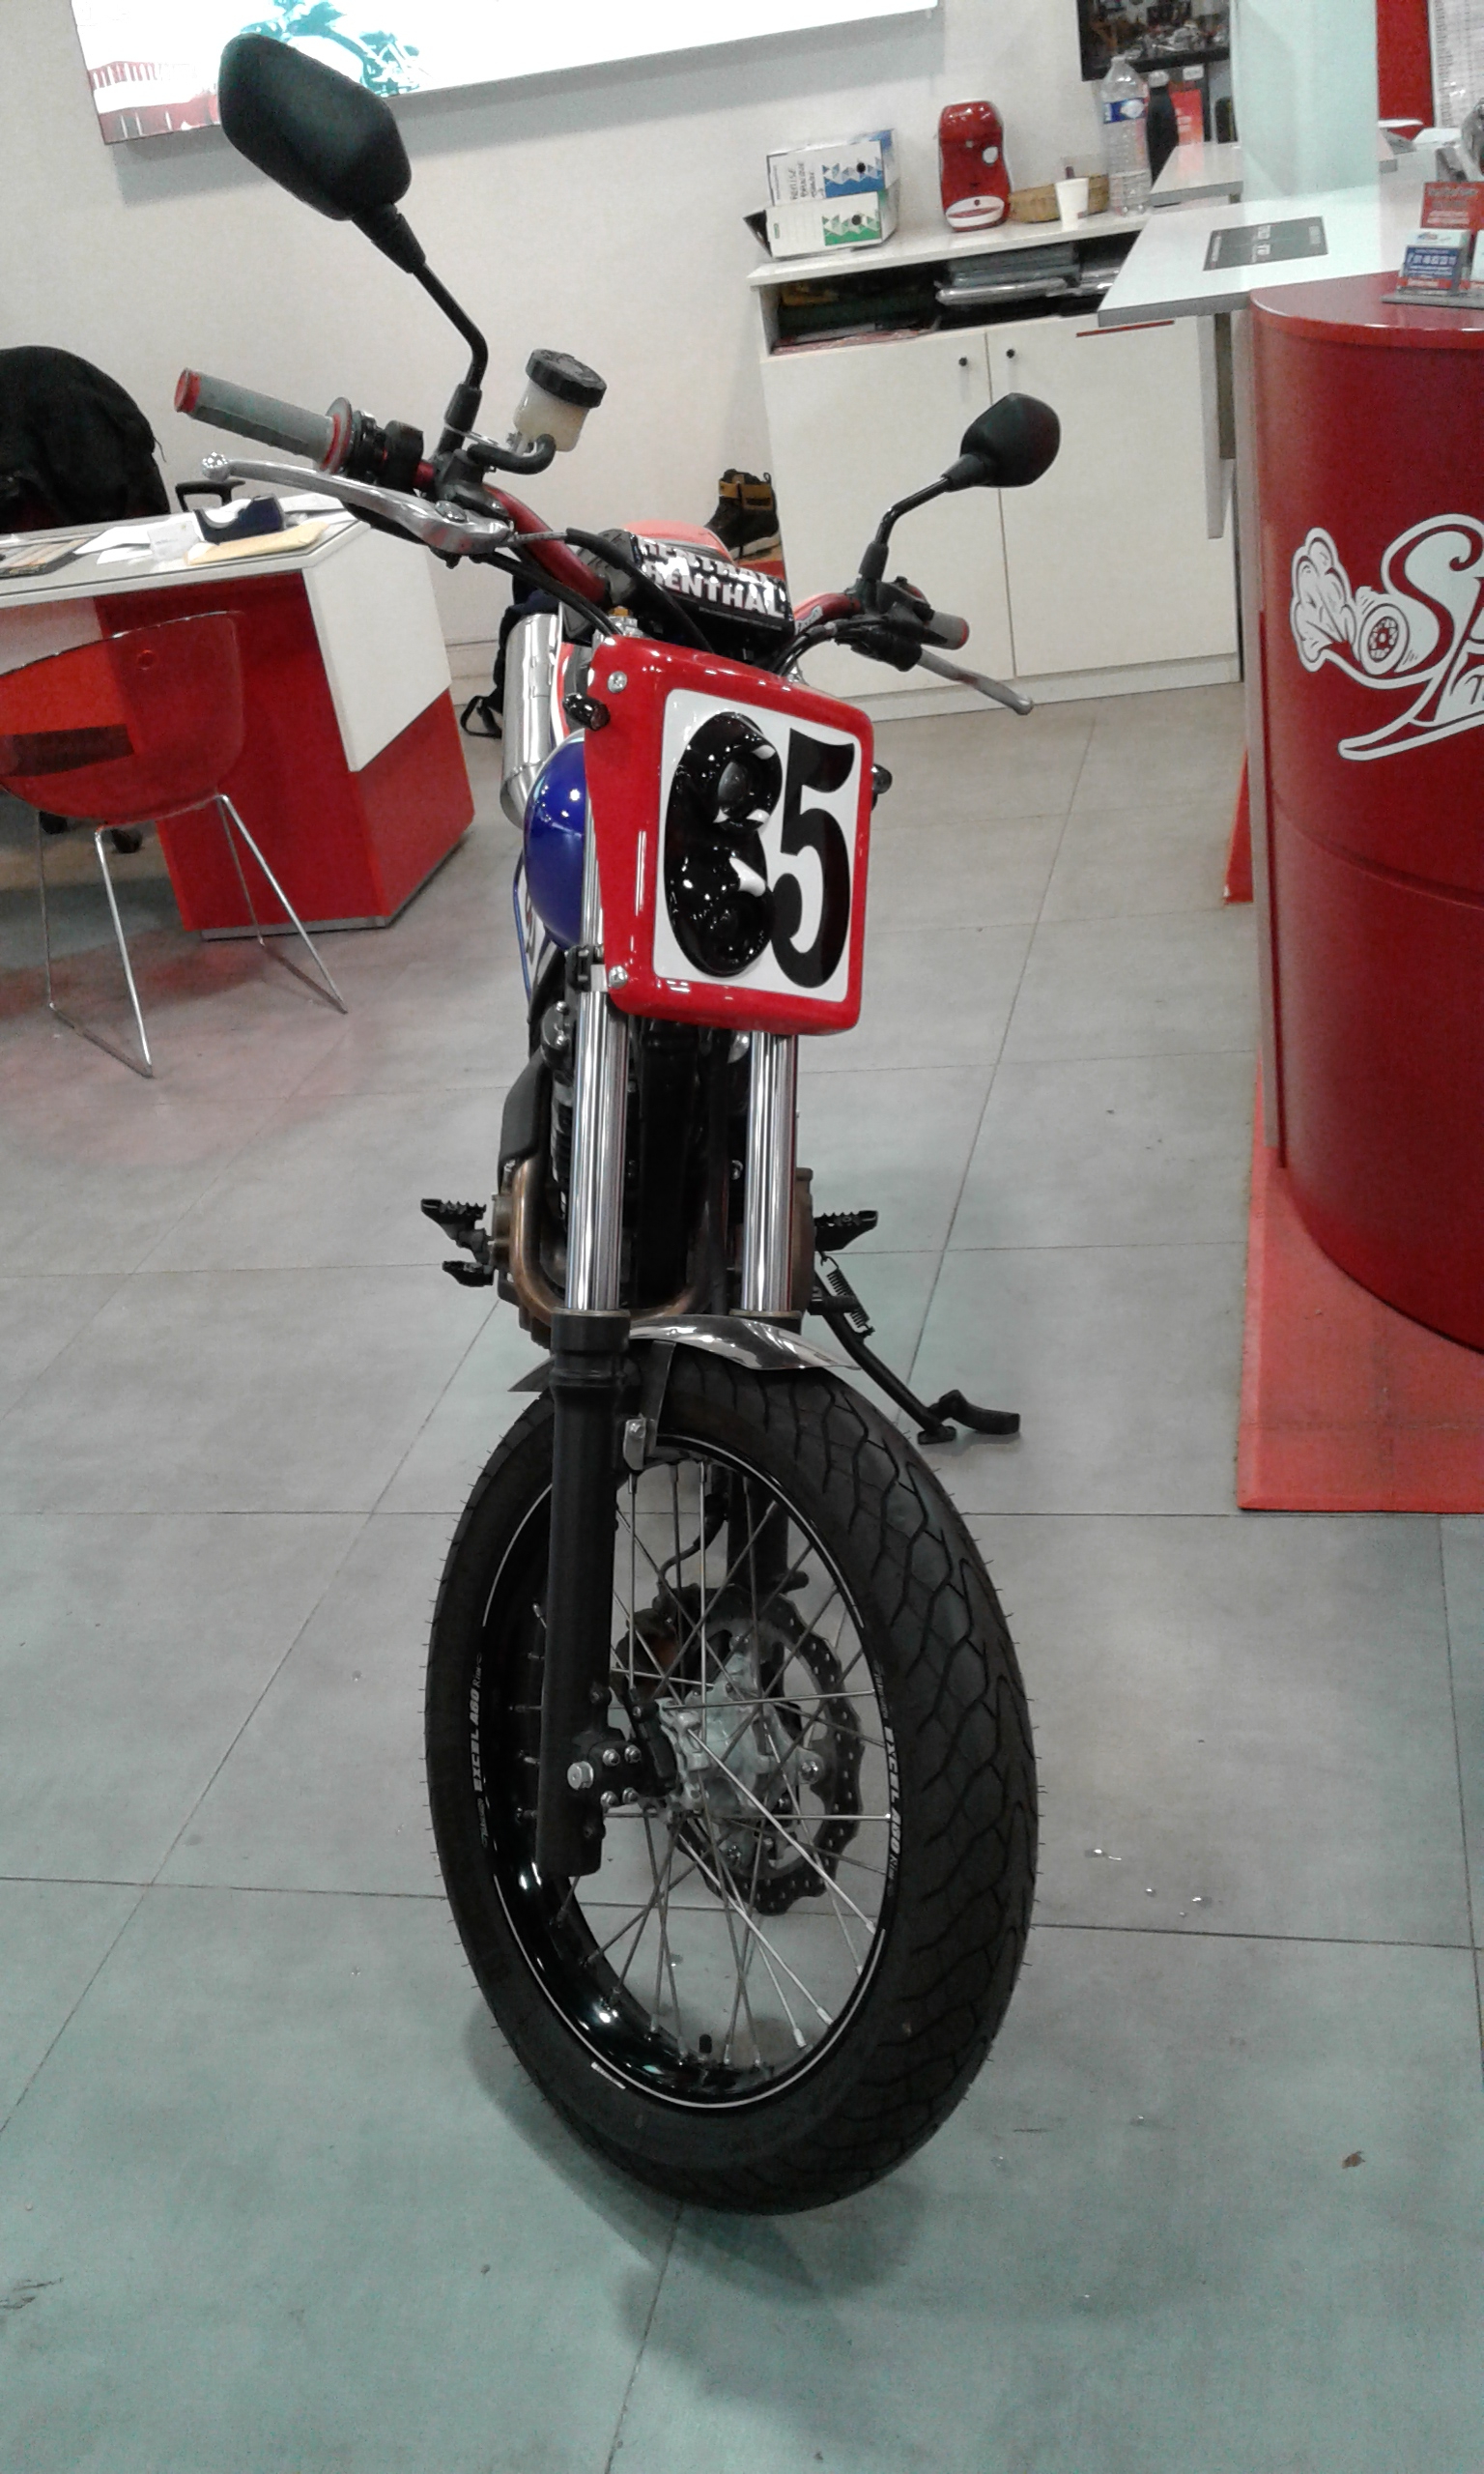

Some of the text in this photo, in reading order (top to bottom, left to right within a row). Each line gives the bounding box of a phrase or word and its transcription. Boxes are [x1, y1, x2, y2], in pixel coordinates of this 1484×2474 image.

[643, 559, 785, 619] RENTHAL
[471, 1729, 483, 1792] EXCEL
[884, 1726, 900, 1804] EXCEL
